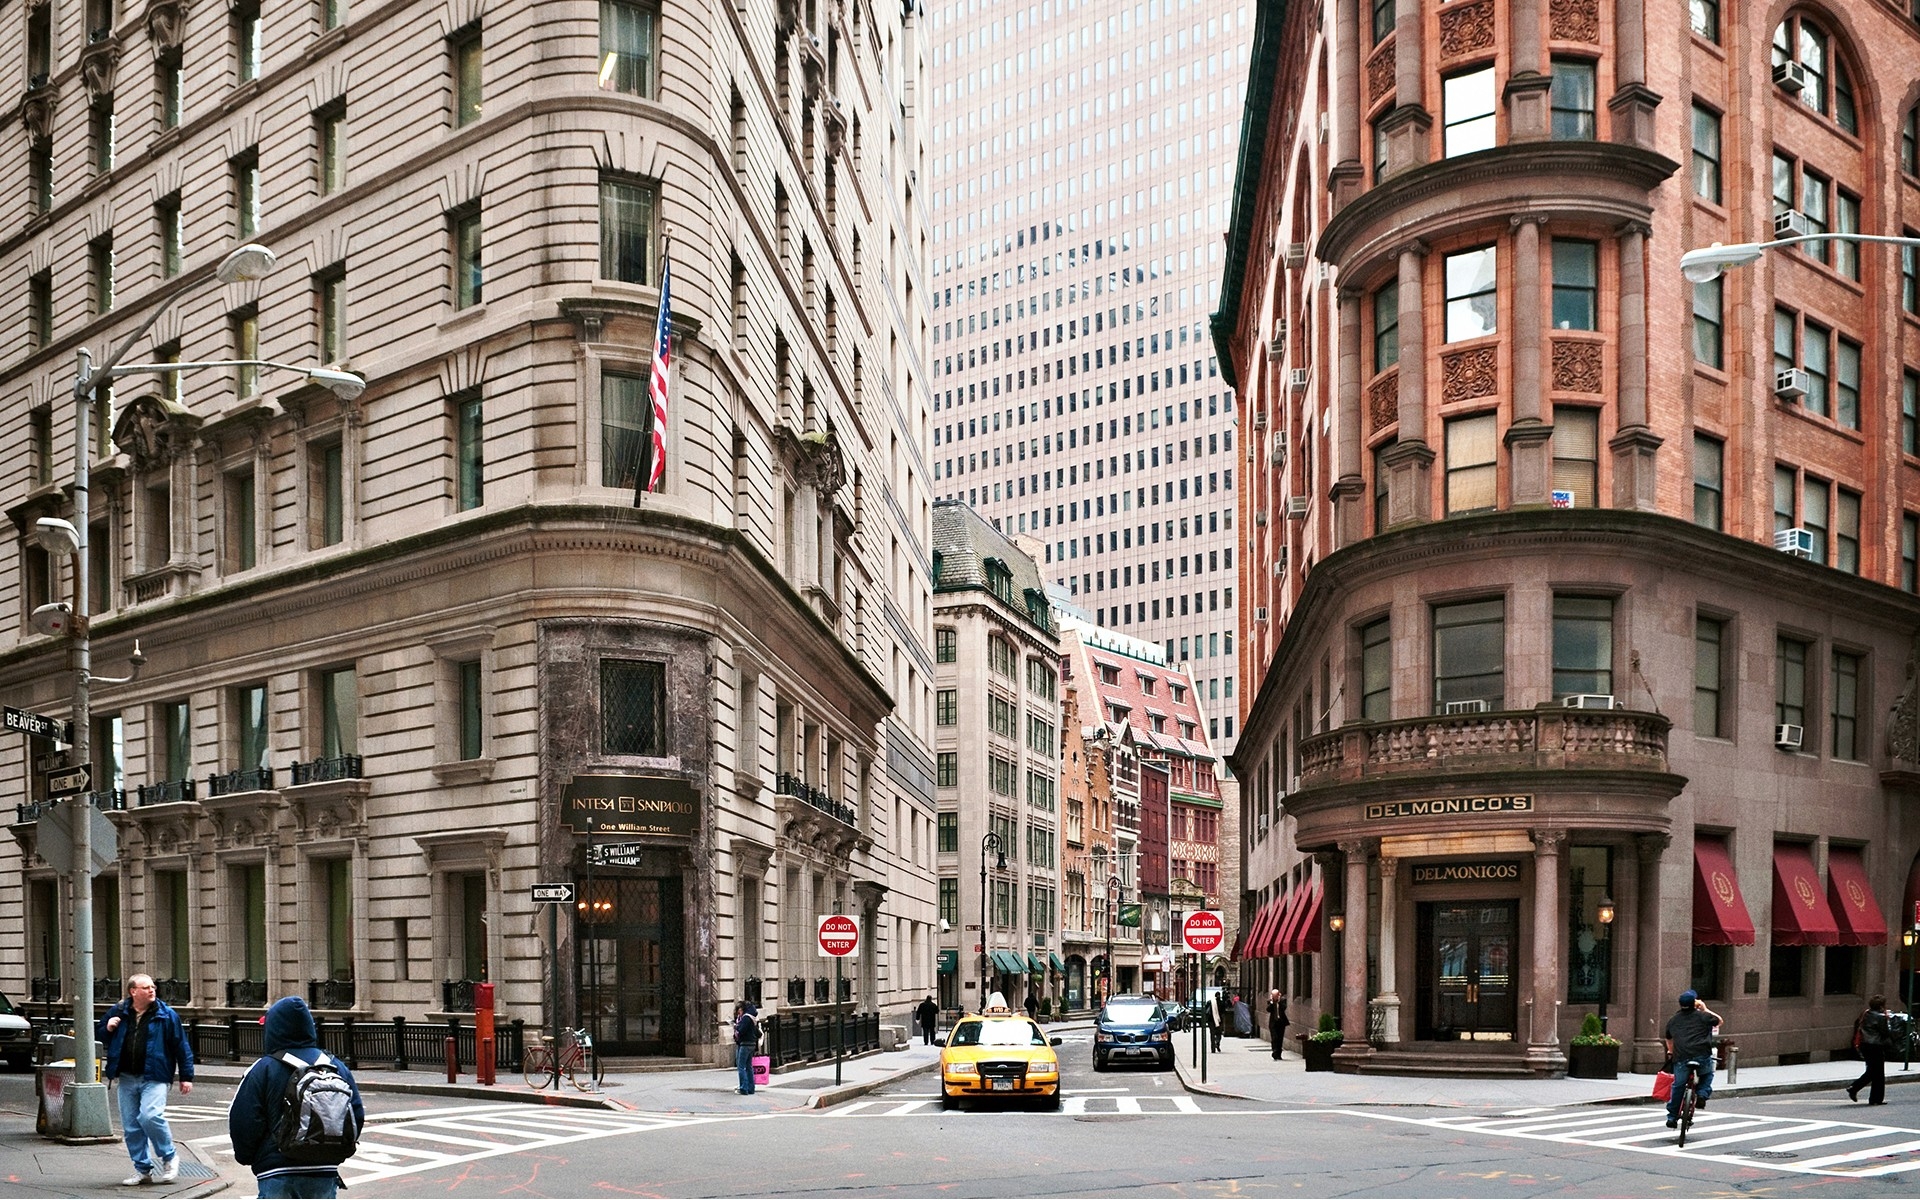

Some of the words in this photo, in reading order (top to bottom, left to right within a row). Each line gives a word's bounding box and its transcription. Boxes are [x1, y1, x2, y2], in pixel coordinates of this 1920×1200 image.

[6, 712, 41, 734] BEAVER
[53, 778, 67, 790] ONE
[72, 773, 86, 786] WAY
[572, 797, 615, 811] INTESA
[637, 799, 693, 815] SANPAOLO
[1369, 797, 1527, 818] DELMONICO'S
[600, 823, 616, 831] One
[618, 823, 647, 831] William
[649, 824, 670, 833] Street
[604, 848, 609, 857] S
[610, 845, 636, 857] WILLIAM
[610, 857, 637, 866] WILLIAM
[1415, 864, 1518, 882] DELMONICOS
[554, 889, 568, 897] WAY
